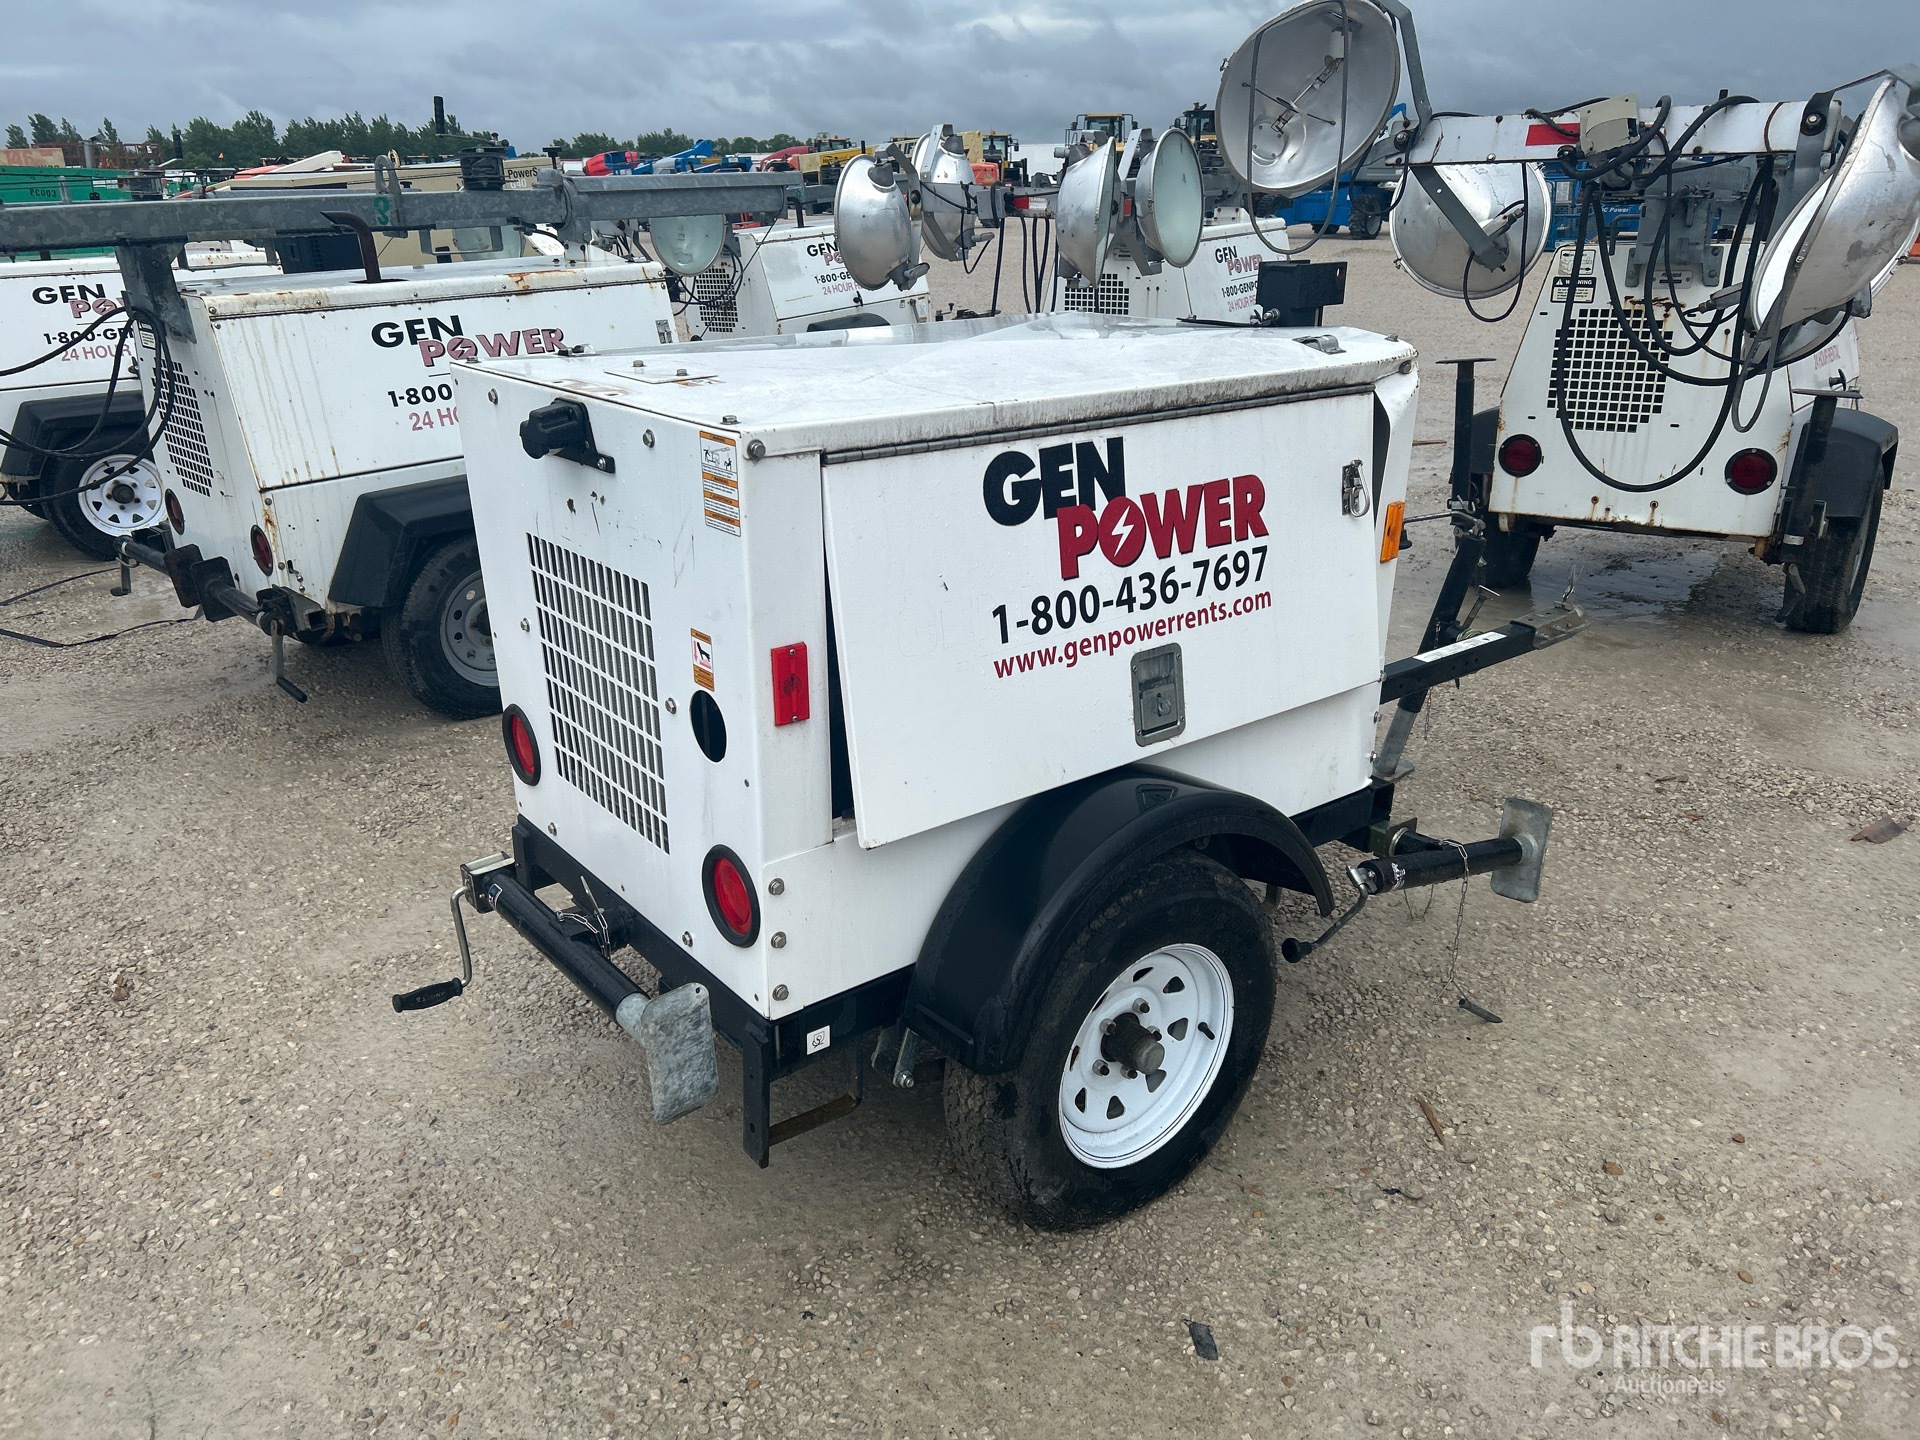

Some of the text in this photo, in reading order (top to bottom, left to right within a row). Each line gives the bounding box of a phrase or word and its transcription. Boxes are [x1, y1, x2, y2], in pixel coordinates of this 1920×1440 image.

[1215, 246, 1238, 263] GEN
[32, 283, 107, 305] GEN
[371, 315, 464, 348] GEN
[408, 411, 434, 431] 24
[983, 436, 1126, 526] GEN
[1057, 474, 1269, 580] POWER
[992, 545, 1268, 644] 1-800-436-7697
[993, 590, 1272, 679] www.genpowerrents.com
